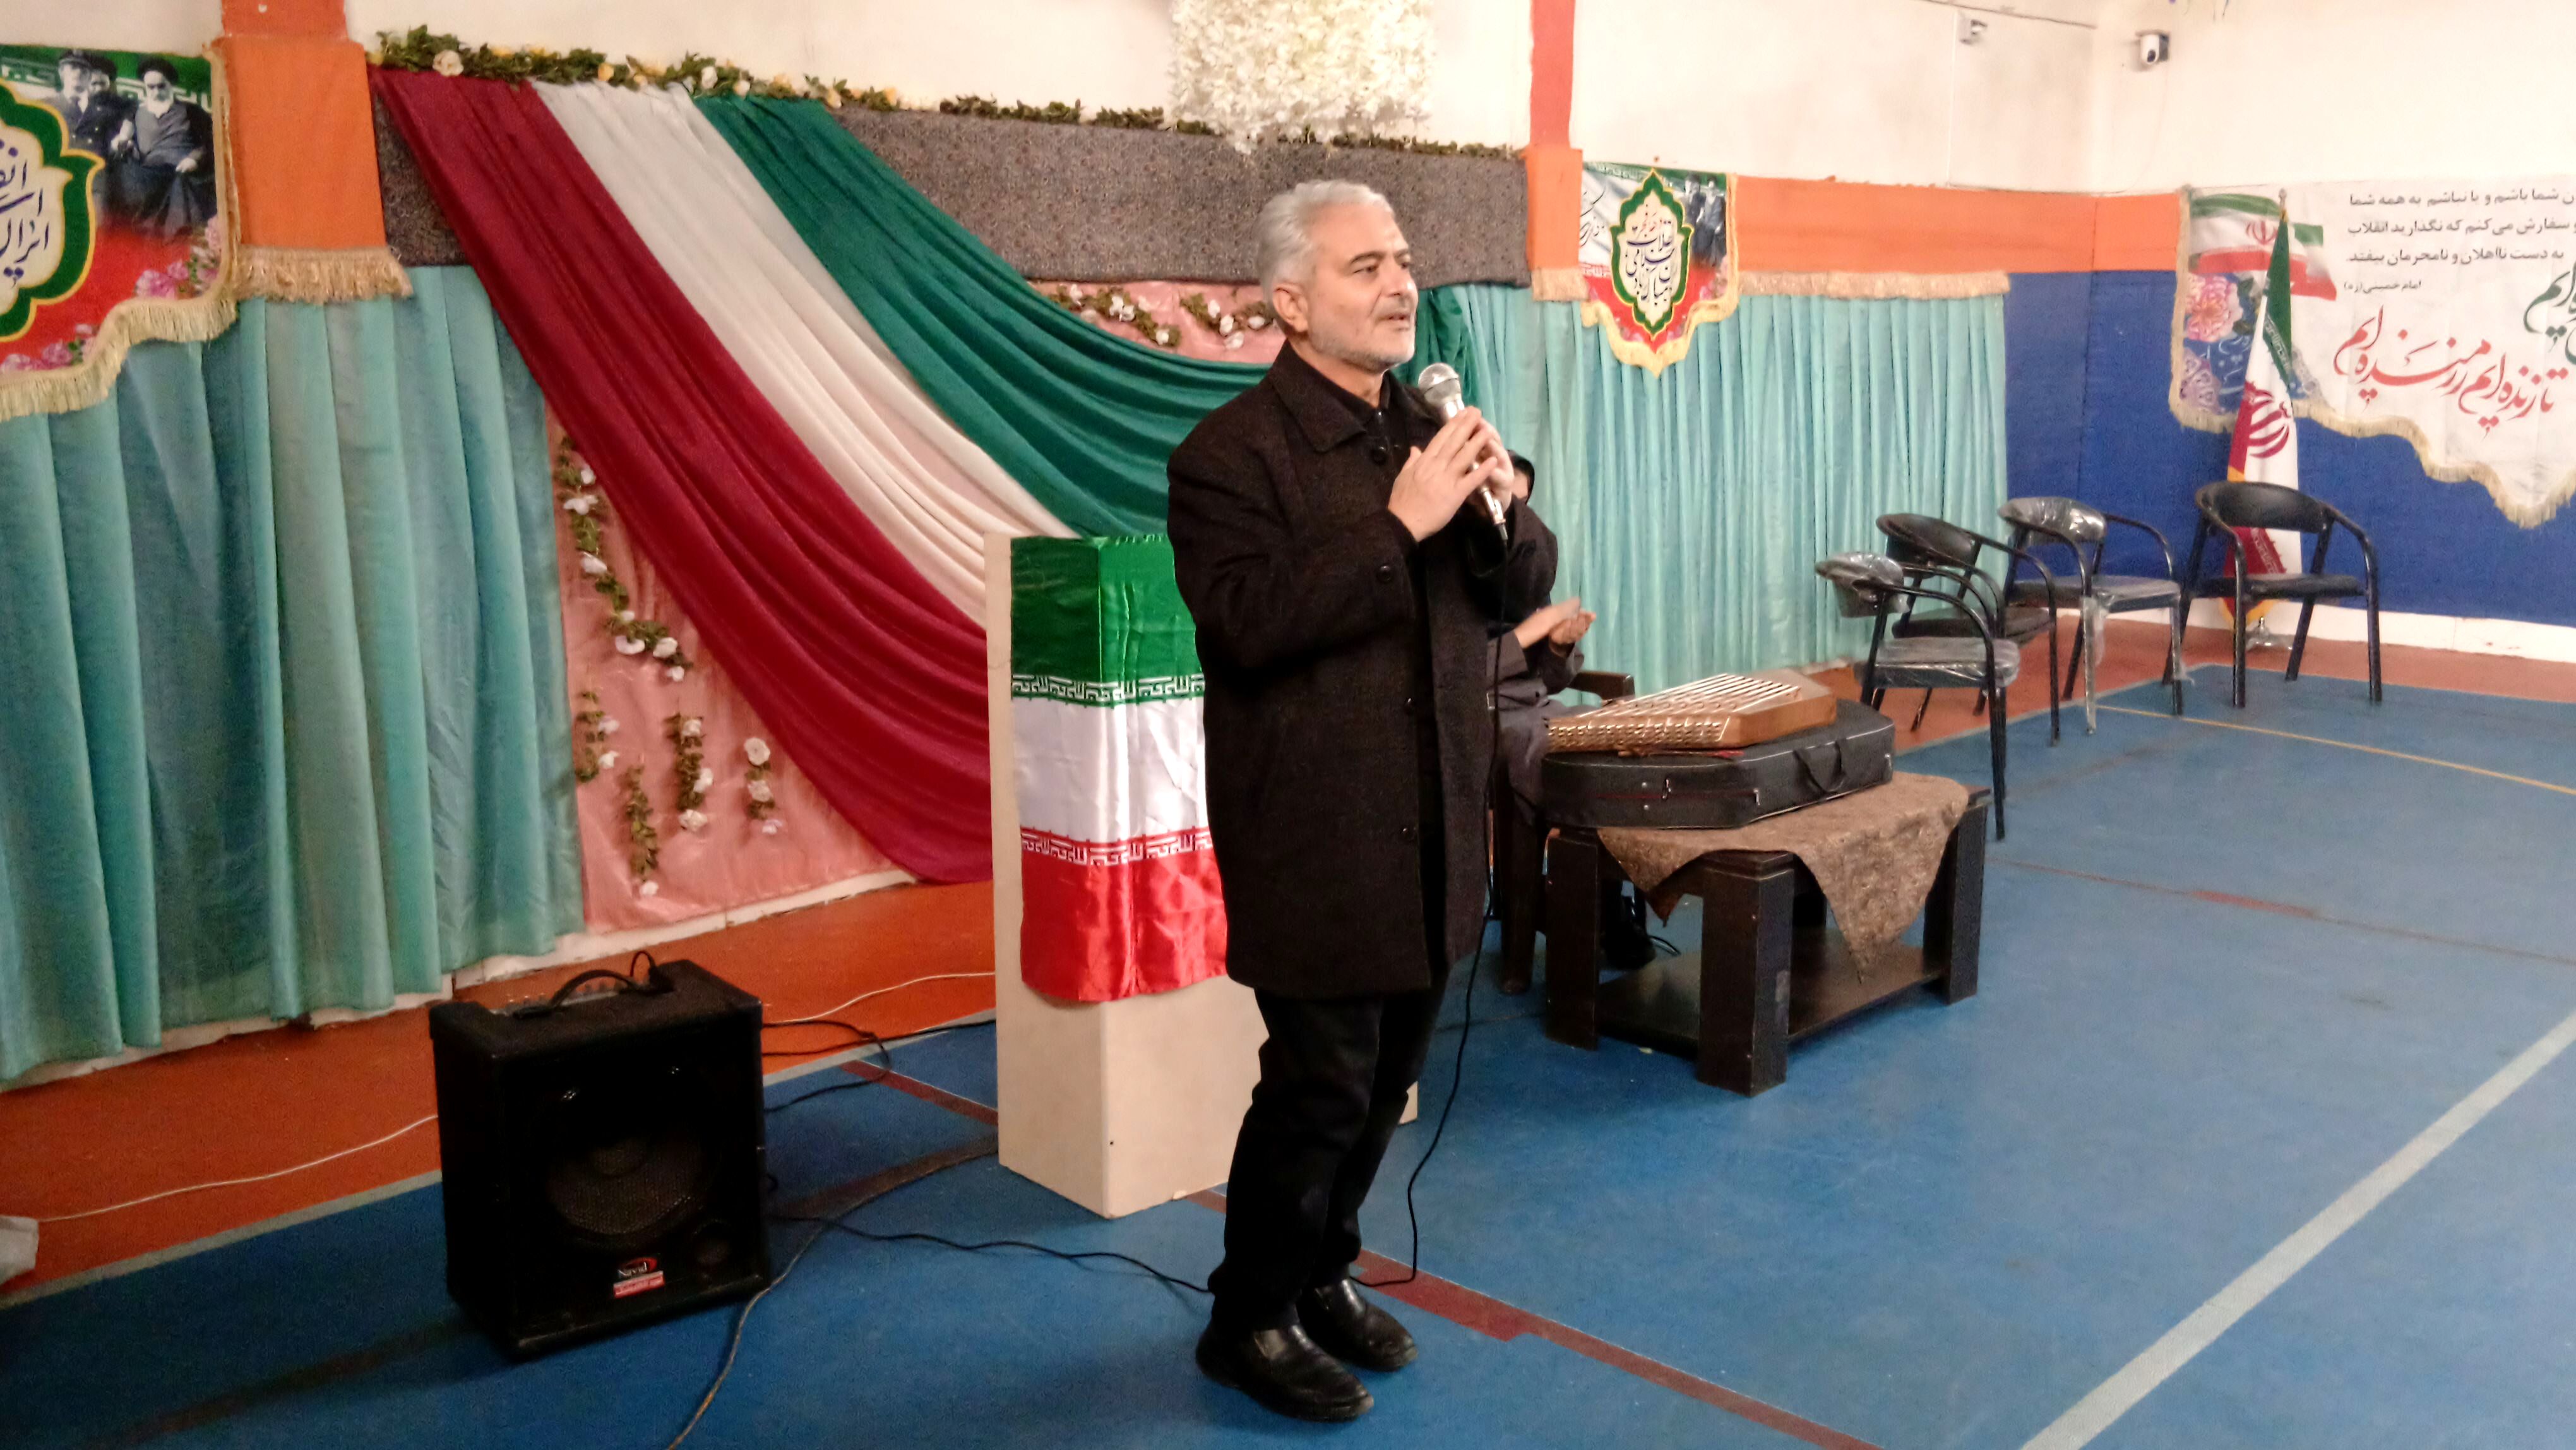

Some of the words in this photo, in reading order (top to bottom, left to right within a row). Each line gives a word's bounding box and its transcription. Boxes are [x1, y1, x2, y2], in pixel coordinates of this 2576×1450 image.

[2350, 193, 2375, 206] شما
[2379, 195, 2405, 205] همه
[2409, 195, 2421, 207] به
[2485, 195, 2491, 206] و
[2495, 188, 2527, 205] باشم
[2532, 188, 2559, 201] شما
[2347, 220, 2388, 236] انقلاب
[2446, 219, 2464, 232] که
[2516, 218, 2570, 235] سفارش
[2451, 253, 2458, 265] و
[2510, 249, 2548, 260] دست
[2551, 250, 2565, 261] به
[2540, 366, 2569, 412] تا
